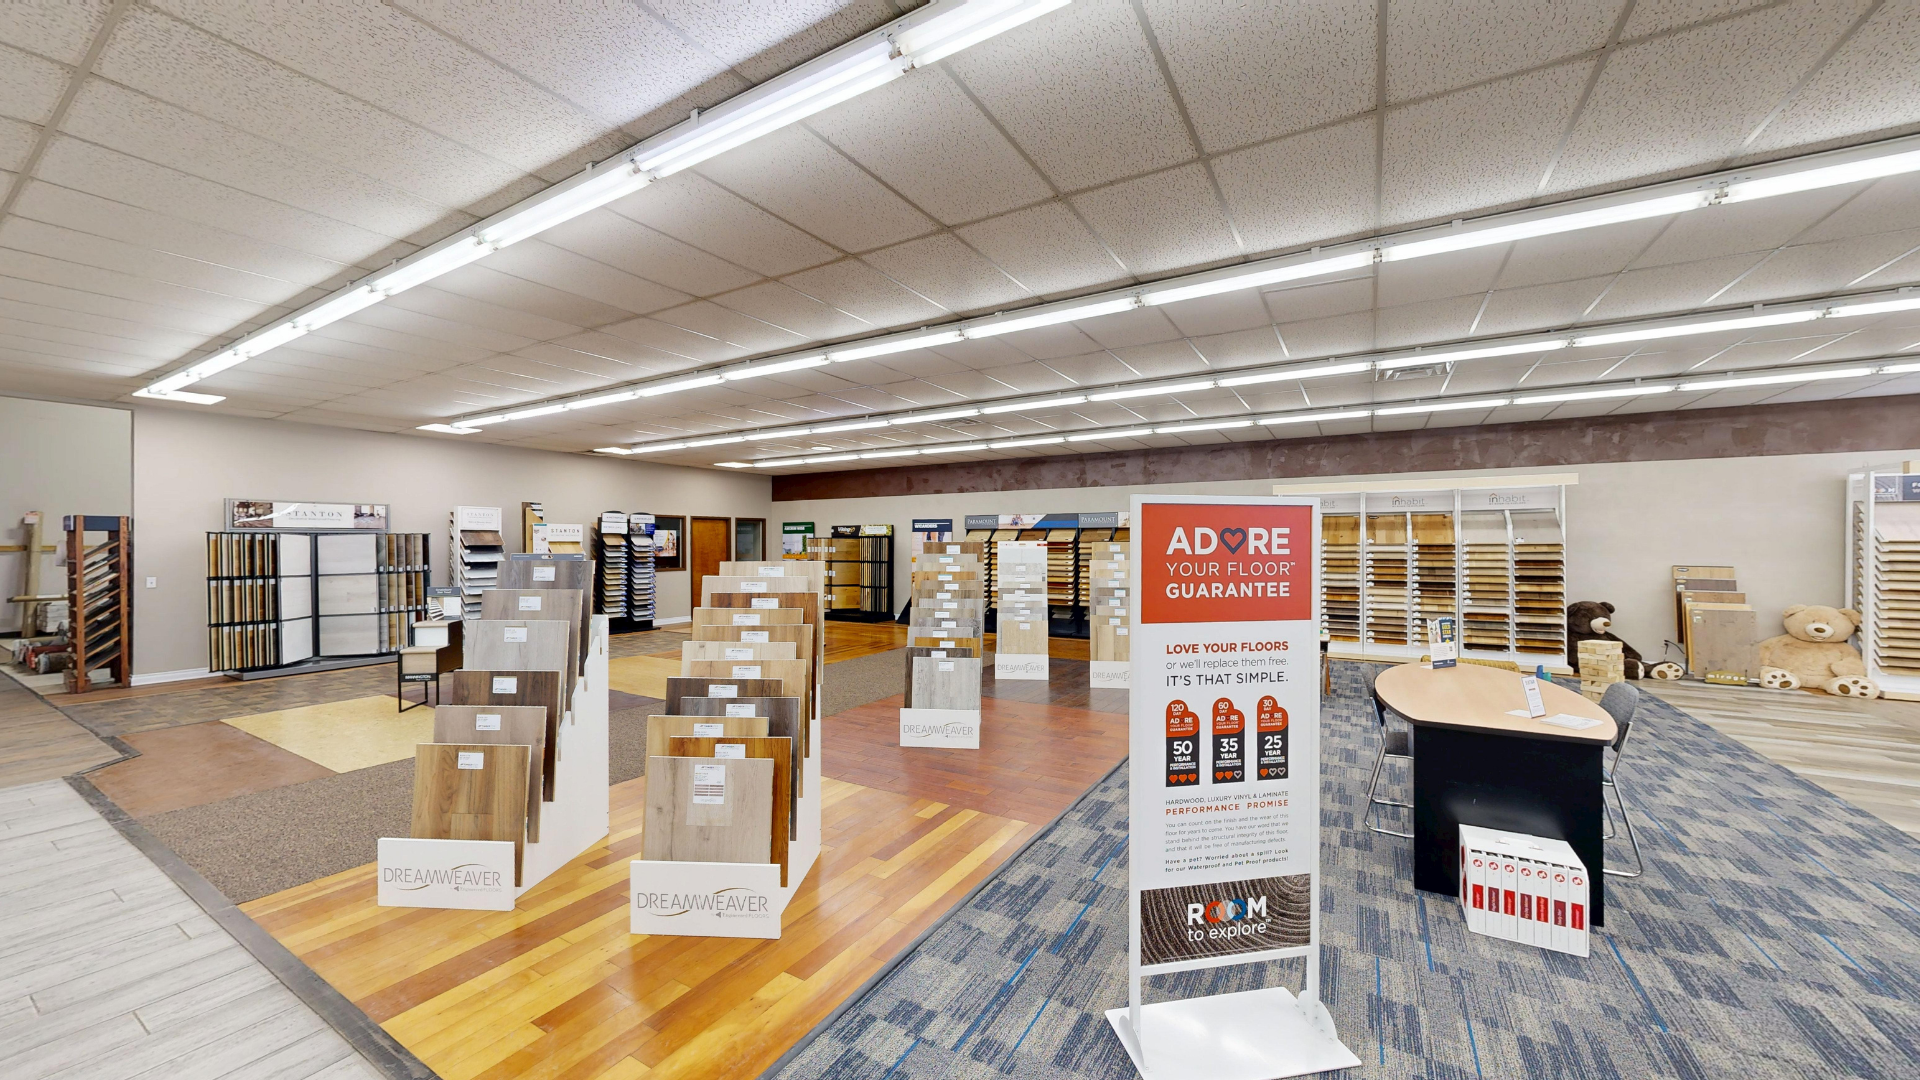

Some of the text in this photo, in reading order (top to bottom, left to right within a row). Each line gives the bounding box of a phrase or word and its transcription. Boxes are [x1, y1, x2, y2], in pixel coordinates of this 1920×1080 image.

[1489, 494, 1526, 502] inhabit
[1166, 562, 1220, 576] YOUR
[1166, 582, 1290, 599] GUARANTEE
[1166, 641, 1289, 654] LOVE YOUR FLOORS
[1166, 656, 1289, 669] or we'll replace them free.
[1166, 671, 1288, 686] IT'S THAT SIMPLE.
[903, 724, 973, 735] DREAMWEAVER
[1173, 740, 1193, 755] 50
[1220, 738, 1238, 752] 35
[1264, 736, 1282, 749] 25
[1166, 800, 1288, 815] PERFORMANCE PROMISE
[384, 868, 501, 886] DREAMWEAVER
[637, 893, 768, 912] DREAMWEAVER
[1188, 896, 1267, 926] ROOM
[1188, 928, 1204, 942] to
